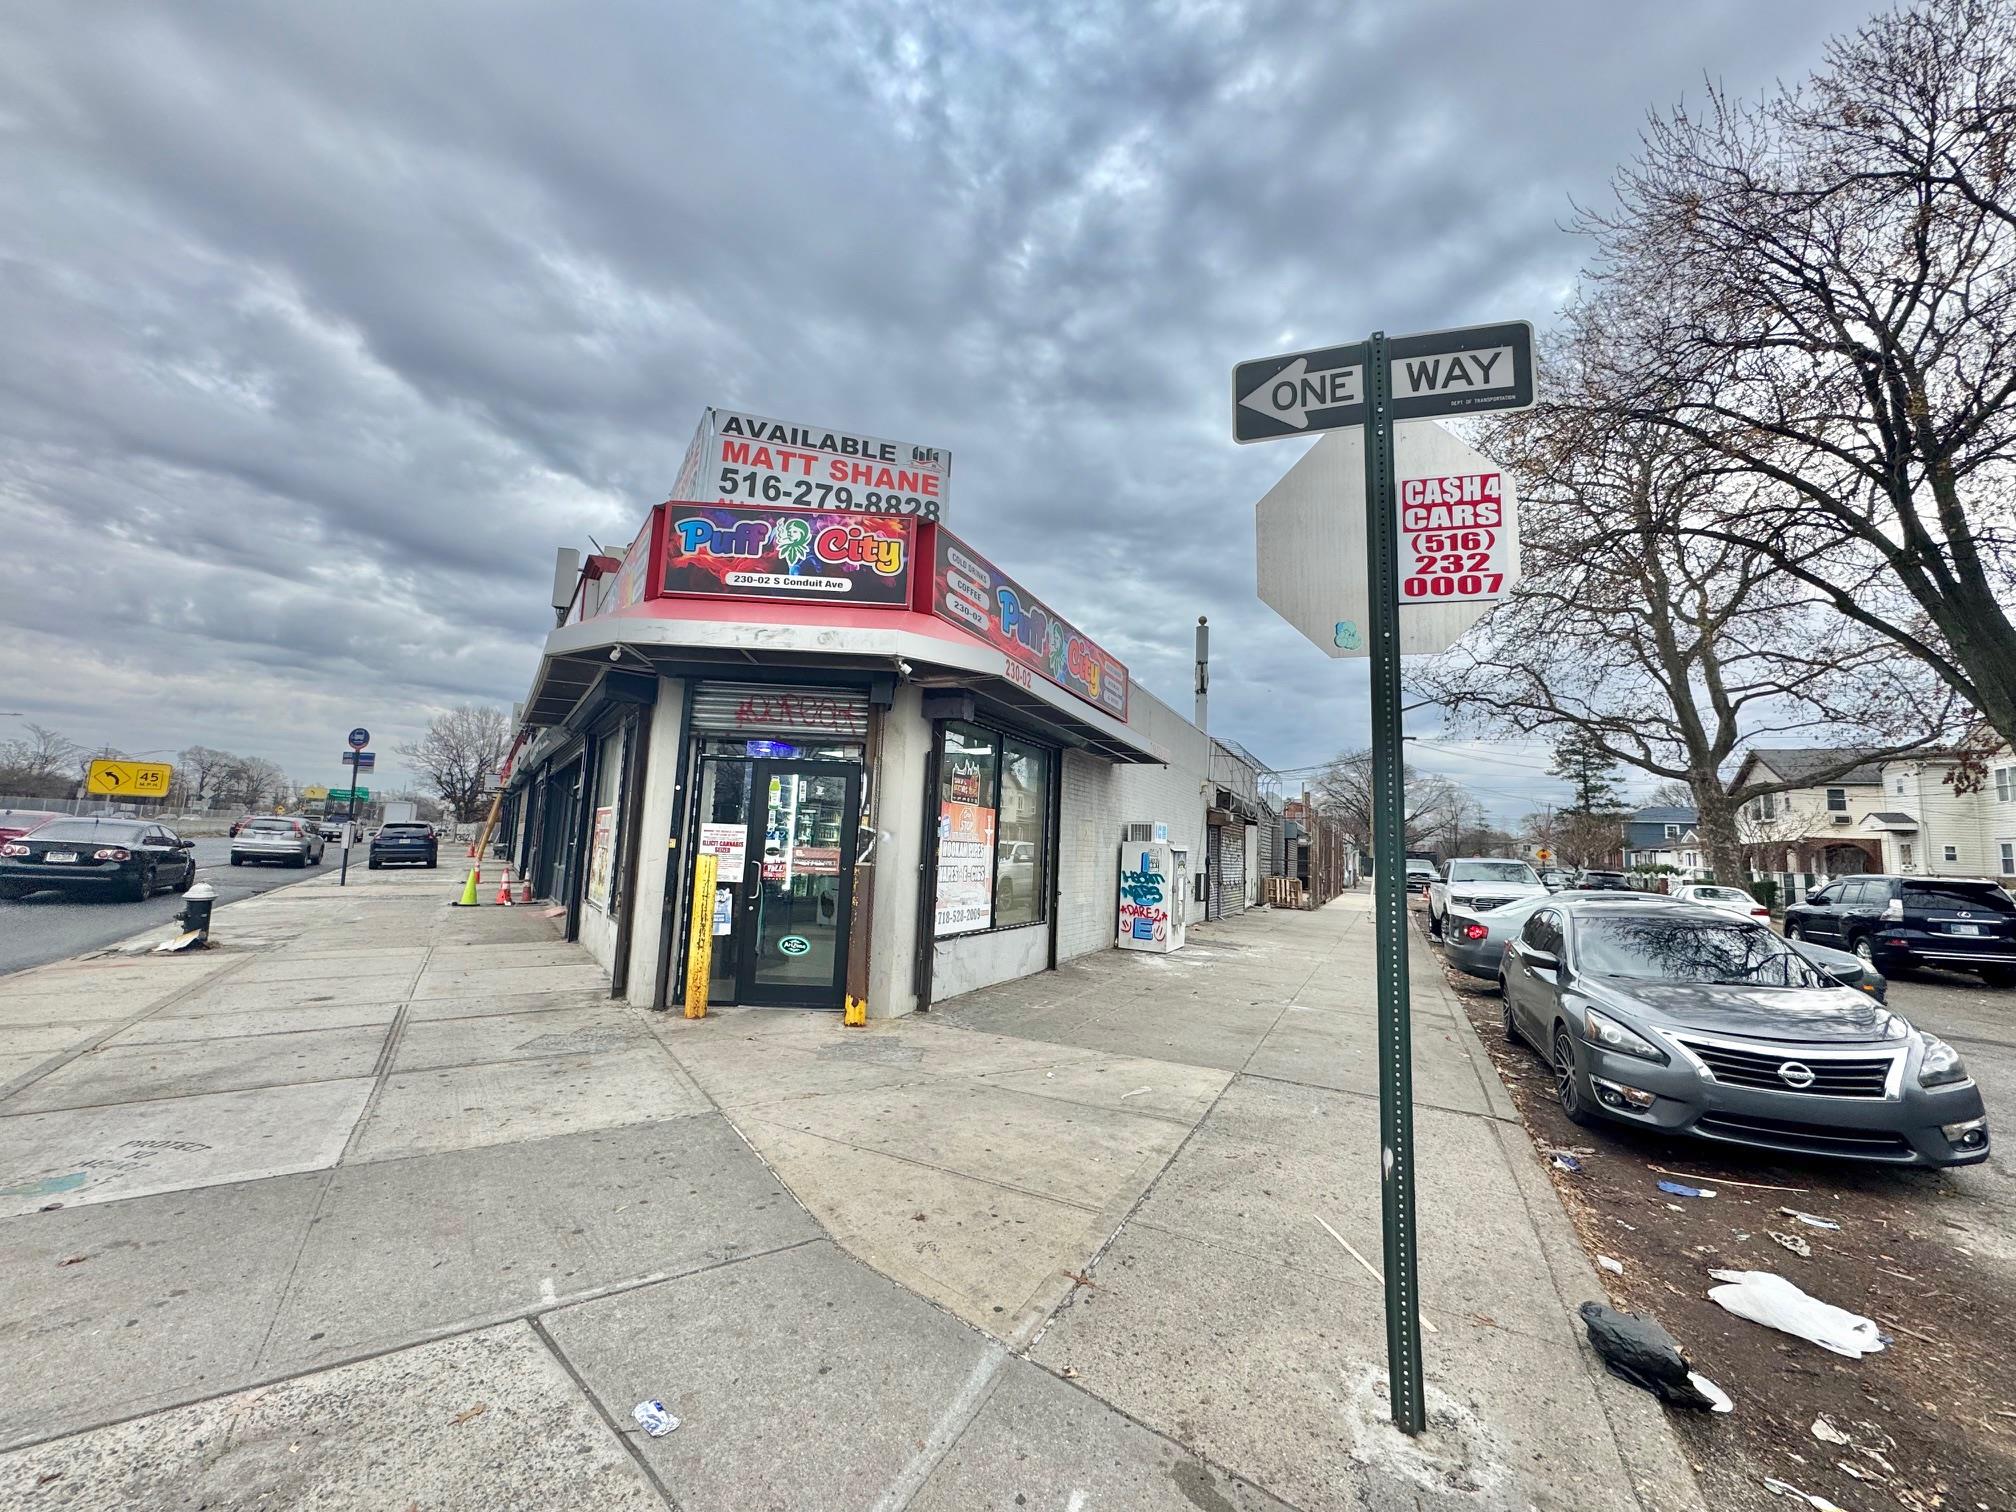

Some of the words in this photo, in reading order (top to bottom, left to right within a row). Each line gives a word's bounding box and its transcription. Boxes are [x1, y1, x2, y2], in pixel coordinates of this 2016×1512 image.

[1272, 370, 1354, 411] ONE
[1406, 351, 1503, 392] WAY
[1474, 395, 1516, 404] TRANSPORTATION
[722, 417, 897, 463] AVAILABLE
[722, 440, 819, 476] MATT
[829, 459, 940, 497] SHANE
[718, 467, 941, 522] 516-279-8828
[1484, 476, 1501, 498] 4
[1405, 502, 1499, 530] CARS
[677, 519, 769, 557] Puff
[817, 527, 902, 574] City
[1411, 529, 1496, 555] (516)
[952, 553, 967, 569] COLD
[968, 565, 987, 584] DRINKS
[1415, 553, 1490, 575] 232
[734, 575, 771, 585] 230-02
[773, 576, 781, 585] S
[783, 577, 822, 588] Conduit
[825, 579, 844, 589] Ave
[957, 580, 982, 601] COFFEE
[1404, 573, 1504, 597] 0007
[953, 600, 982, 623] 230-02
[998, 588, 1047, 656] Puff
[1067, 637, 1100, 698] City
[1005, 659, 1032, 689] 230-02
[140, 772, 159, 782] 45
[119, 1140, 213, 1152] PROTECT
